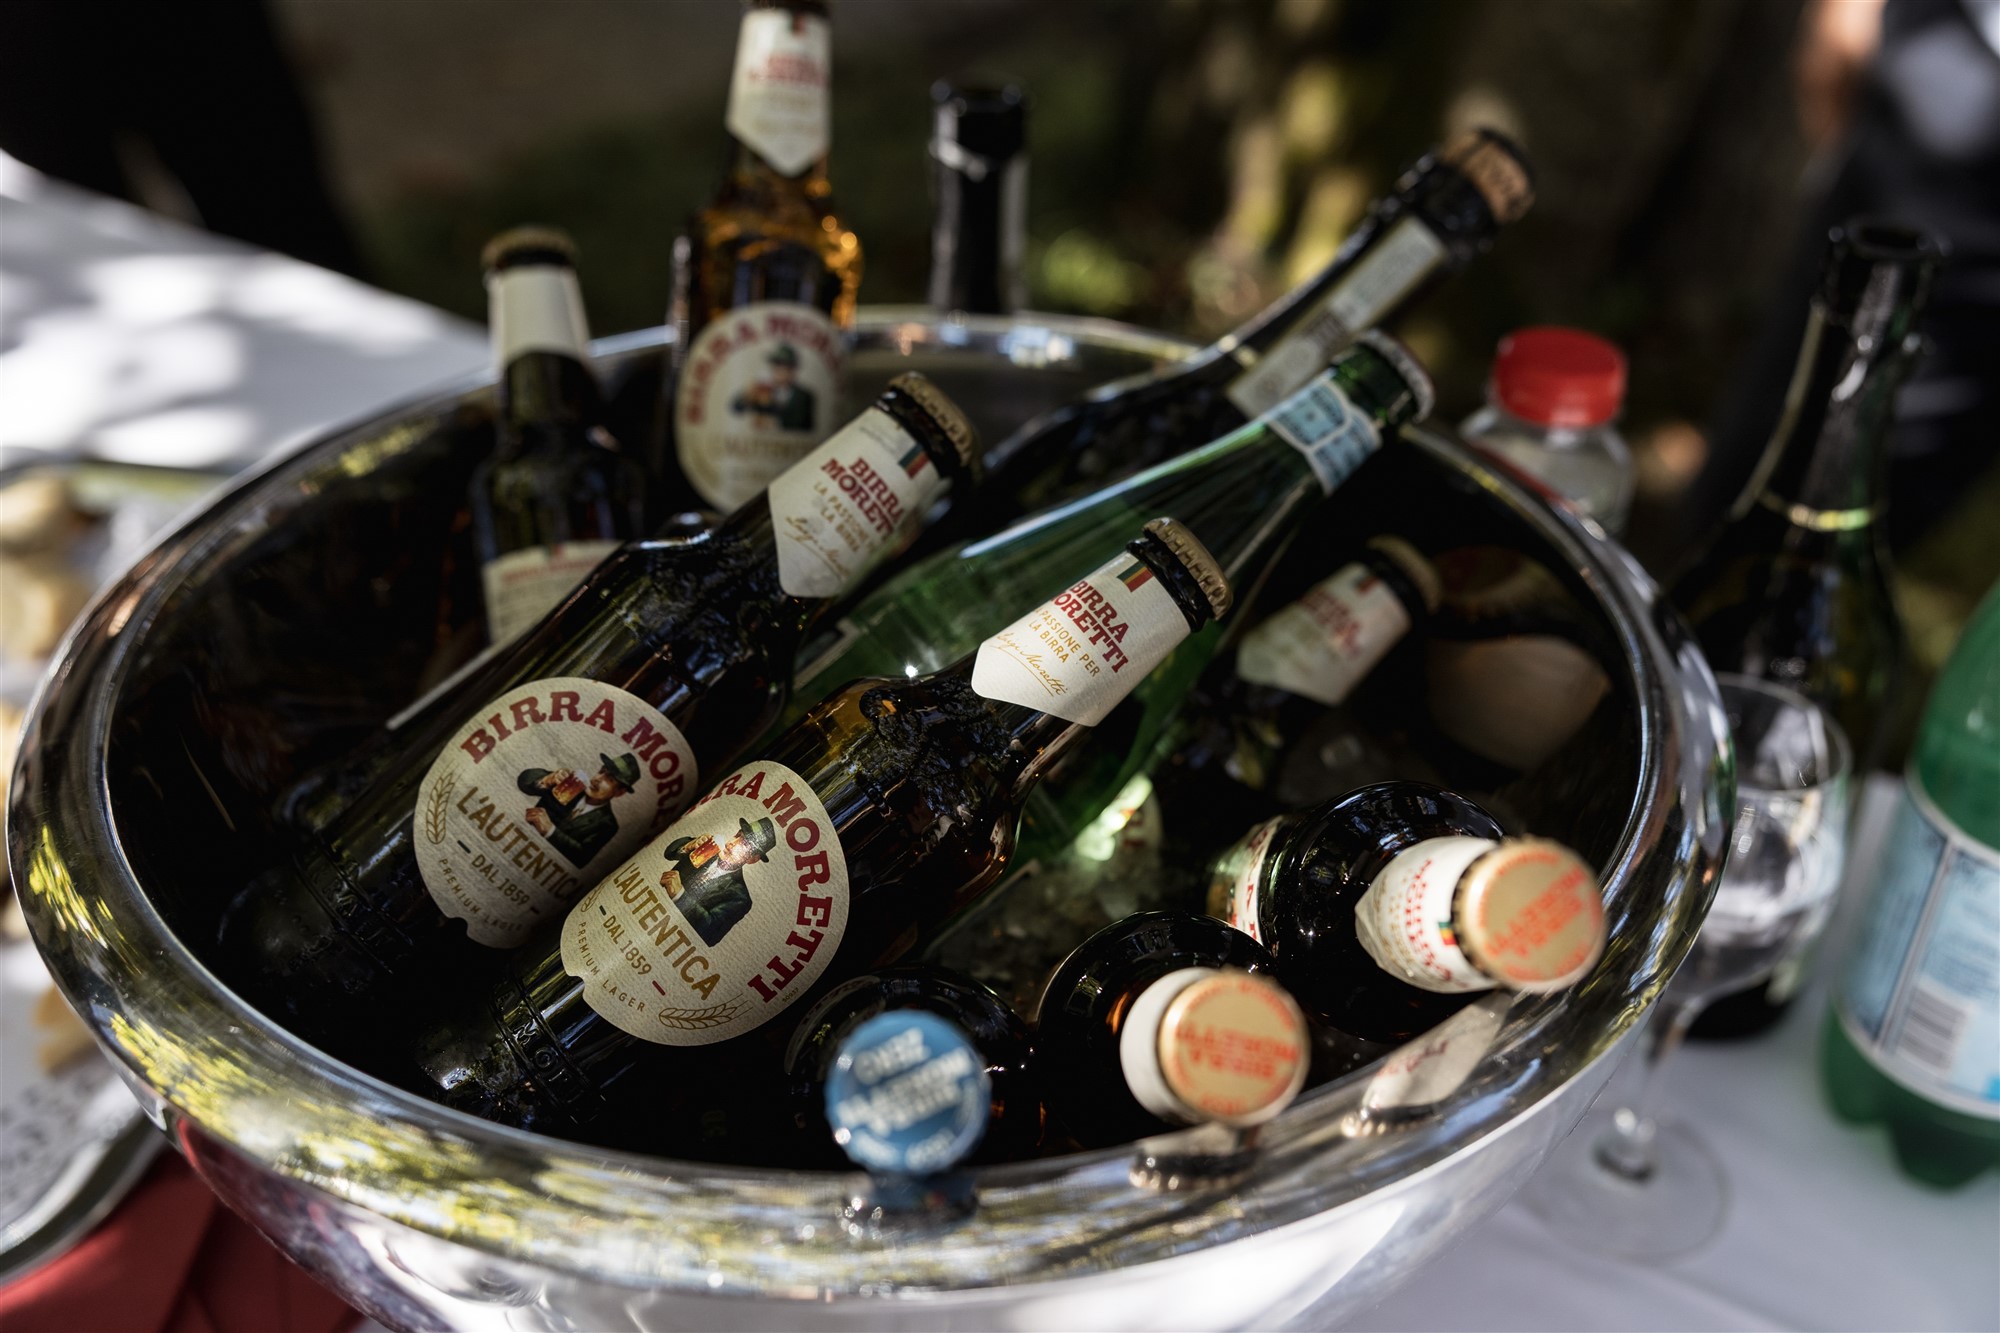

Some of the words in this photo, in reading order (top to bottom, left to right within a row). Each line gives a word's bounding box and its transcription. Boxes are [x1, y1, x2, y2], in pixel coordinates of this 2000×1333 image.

[1028, 620, 1042, 632] LA
[1040, 629, 1070, 663] BIRRA
[1040, 610, 1082, 653] PASSIONE
[1079, 653, 1100, 677] PER
[1052, 592, 1129, 673] ORETTI
[1070, 580, 1130, 643] BIRRA
[460, 690, 617, 764] BIRRA
[621, 716, 685, 834] MORE
[439, 857, 482, 915] PREMIUM
[471, 854, 499, 884] DAL
[497, 877, 531, 906] 1859
[748, 782, 834, 1004] MORETTI
[602, 915, 625, 945] DAL
[619, 939, 653, 975] 1859
[613, 862, 721, 1001] L'AUTENTICA
[578, 921, 601, 976] PREMIUM
[602, 979, 646, 1013] LAGER
